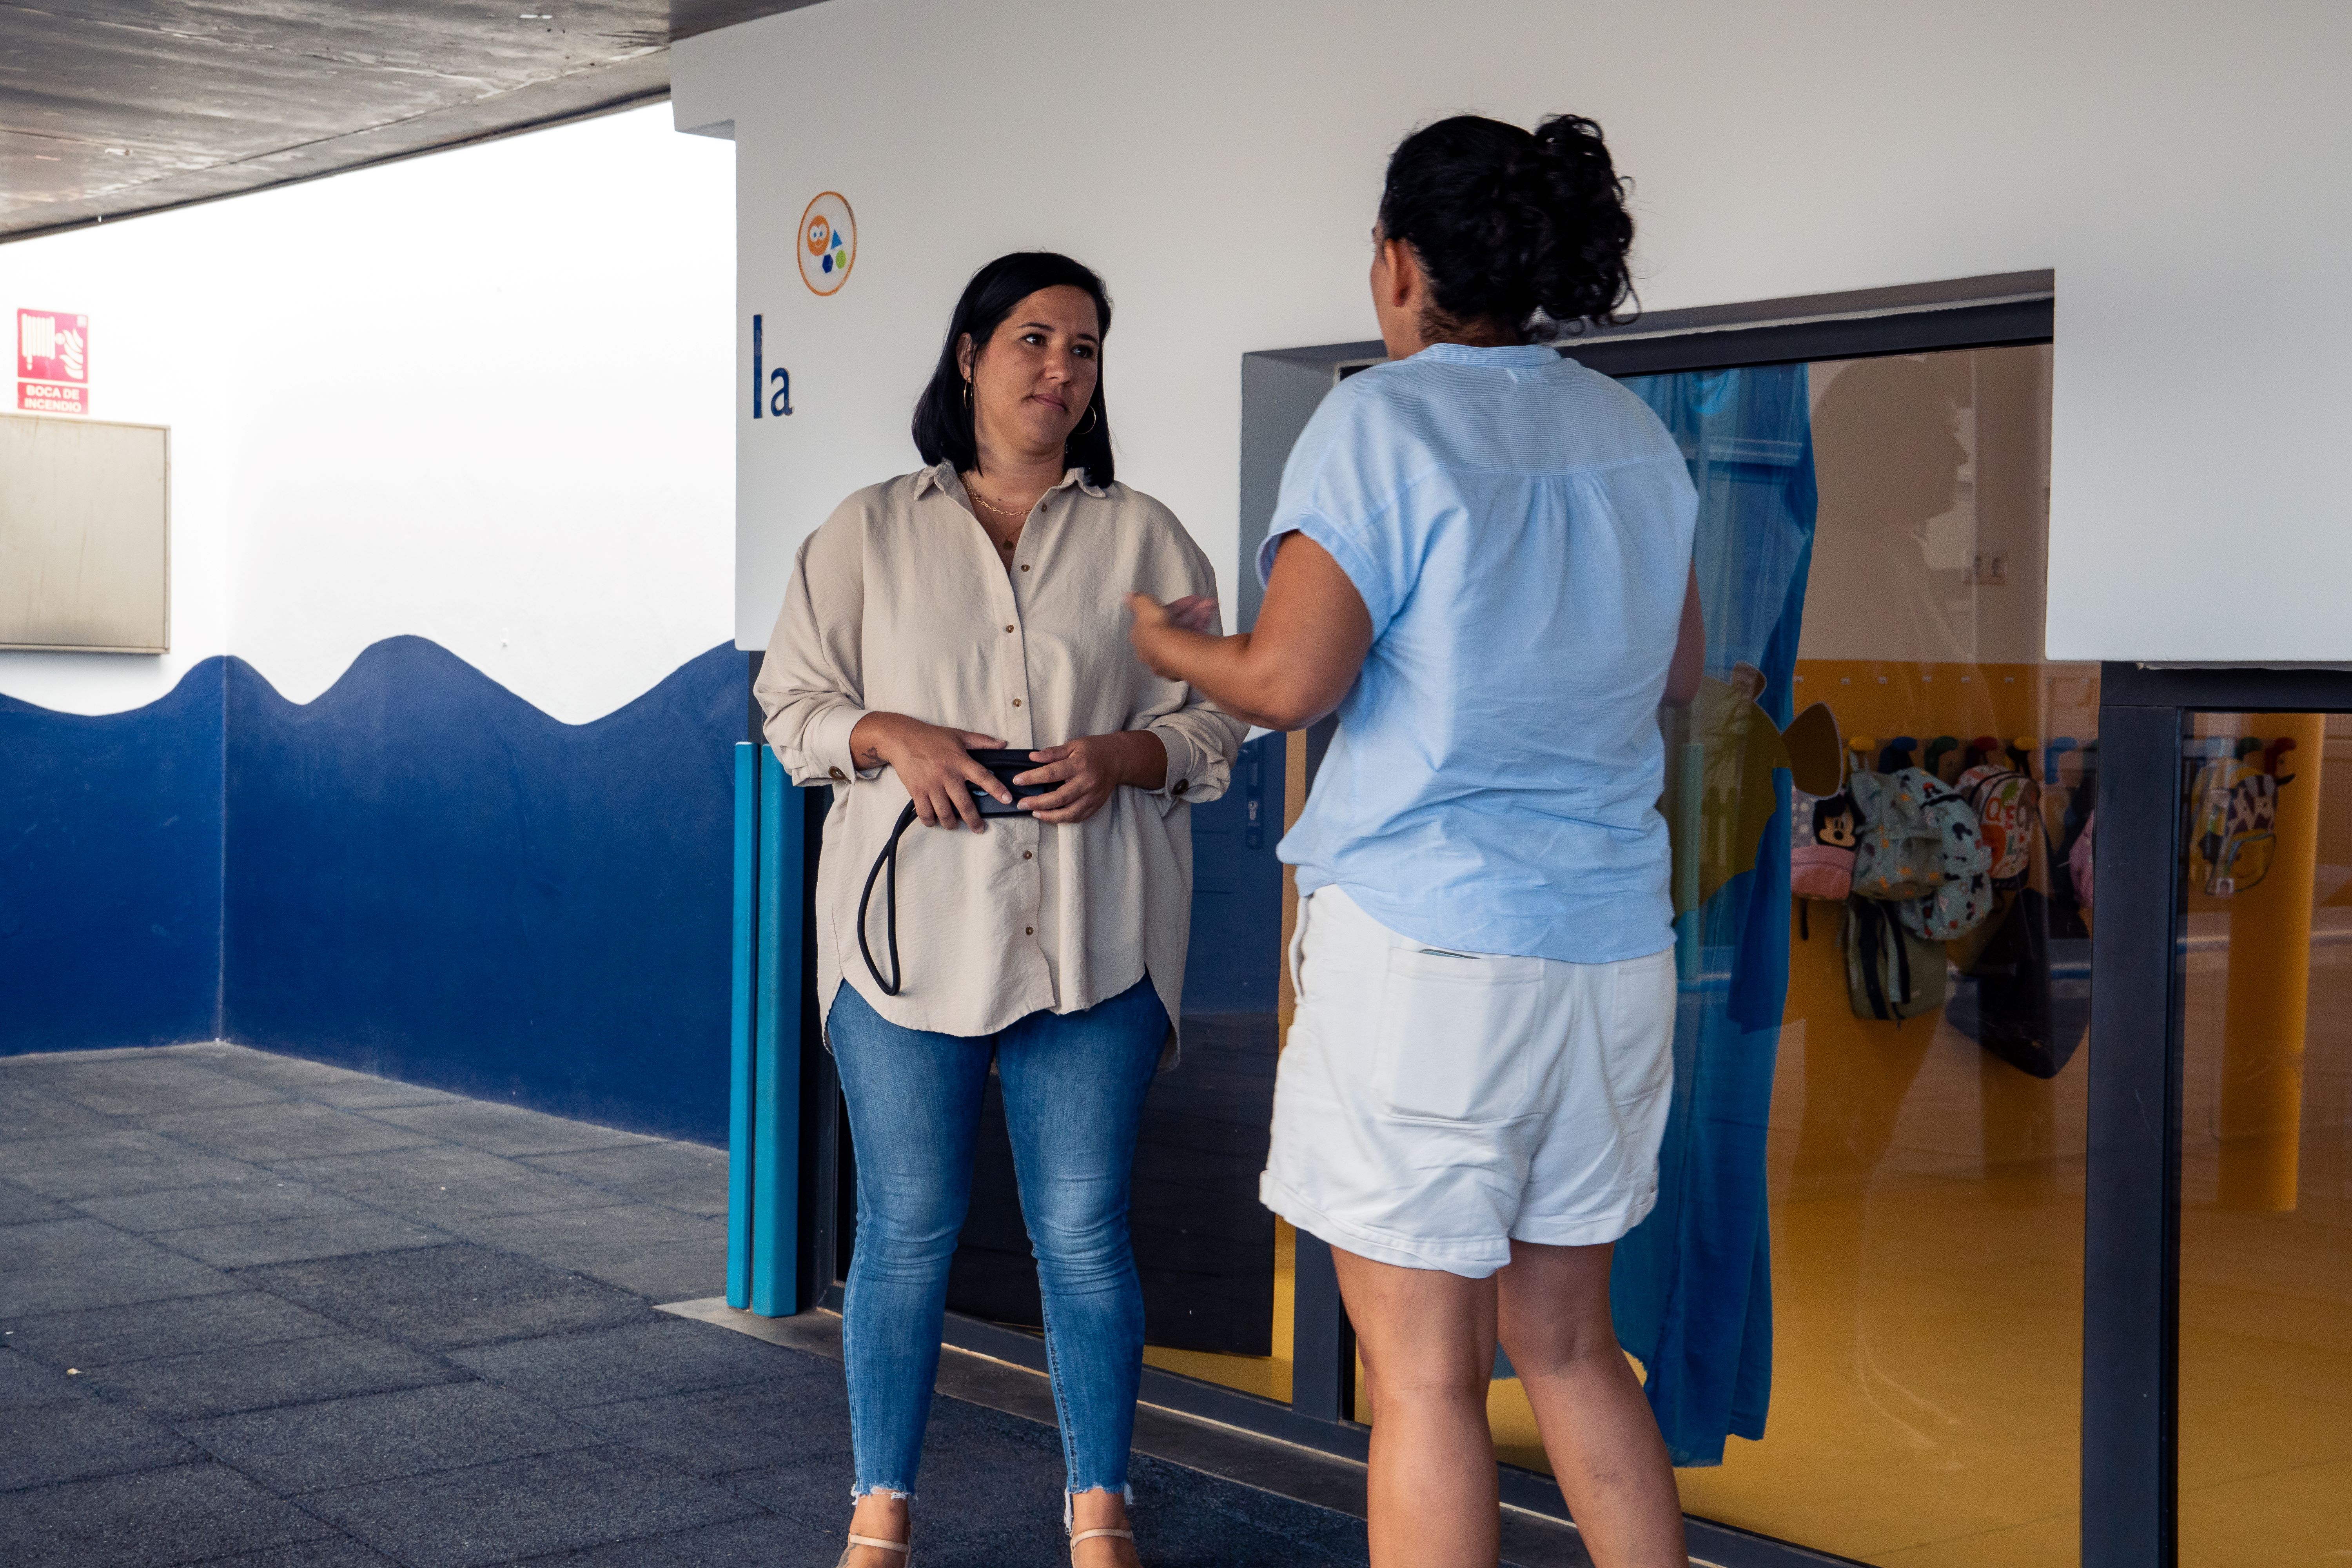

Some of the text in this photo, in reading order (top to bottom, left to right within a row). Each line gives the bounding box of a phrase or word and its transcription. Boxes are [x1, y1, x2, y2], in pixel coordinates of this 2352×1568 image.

[753, 314, 793, 418] la
[27, 385, 80, 399] BOCA DE
[24, 398, 82, 412] INCENDIO
